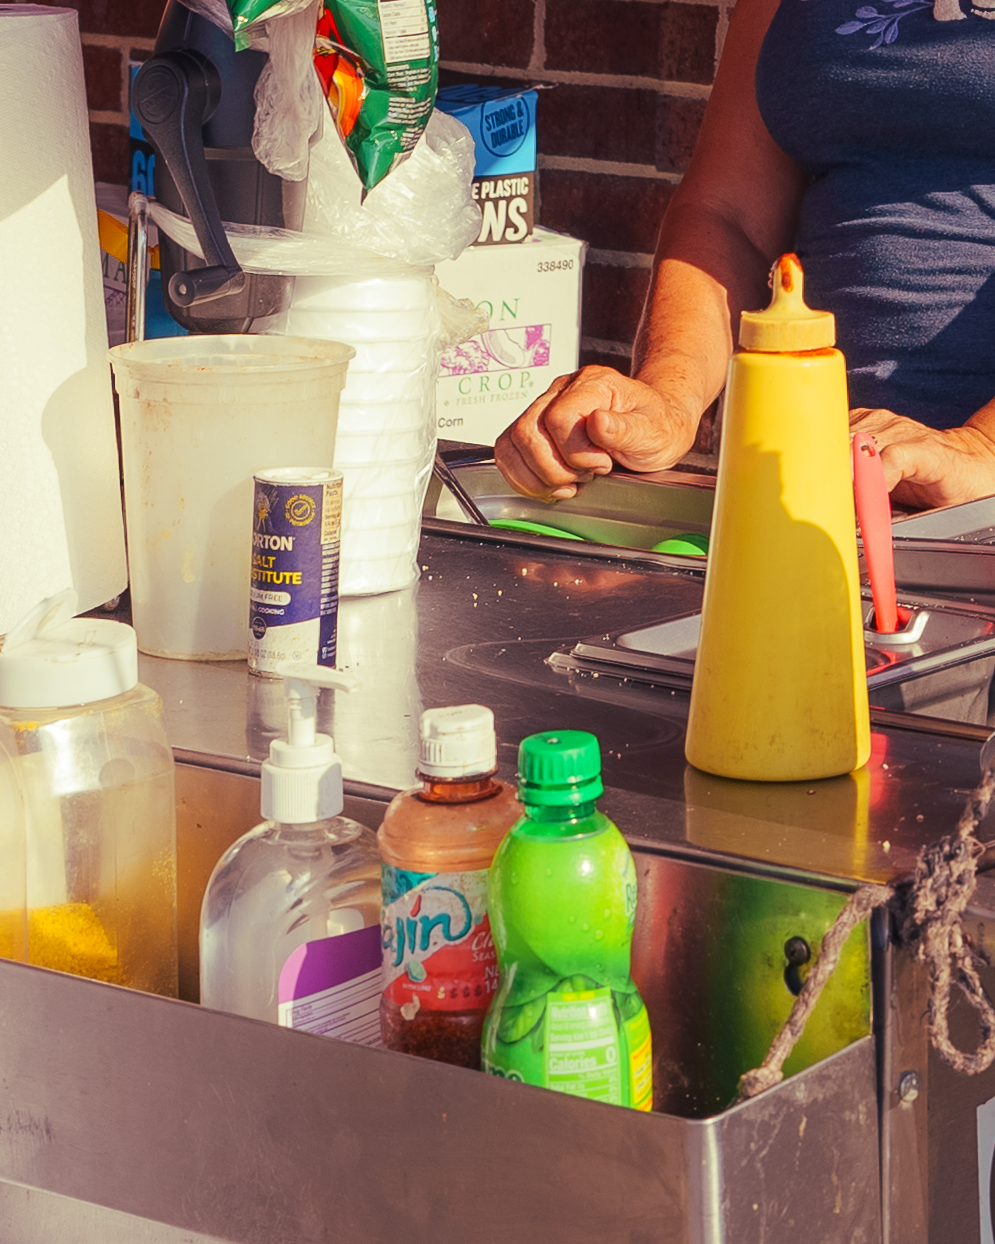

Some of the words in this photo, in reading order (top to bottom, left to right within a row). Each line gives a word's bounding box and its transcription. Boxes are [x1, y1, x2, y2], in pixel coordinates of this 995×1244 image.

[485, 104, 516, 132] STRONG
[517, 101, 524, 118] &
[490, 119, 524, 149] DURABLE
[481, 177, 529, 199] PLASTIC
[537, 259, 574, 273] 338490
[490, 391, 528, 403] FROZEN
[438, 417, 464, 429] Corn
[549, 1056, 598, 1071] Calories
[605, 1045, 616, 1063] 0
